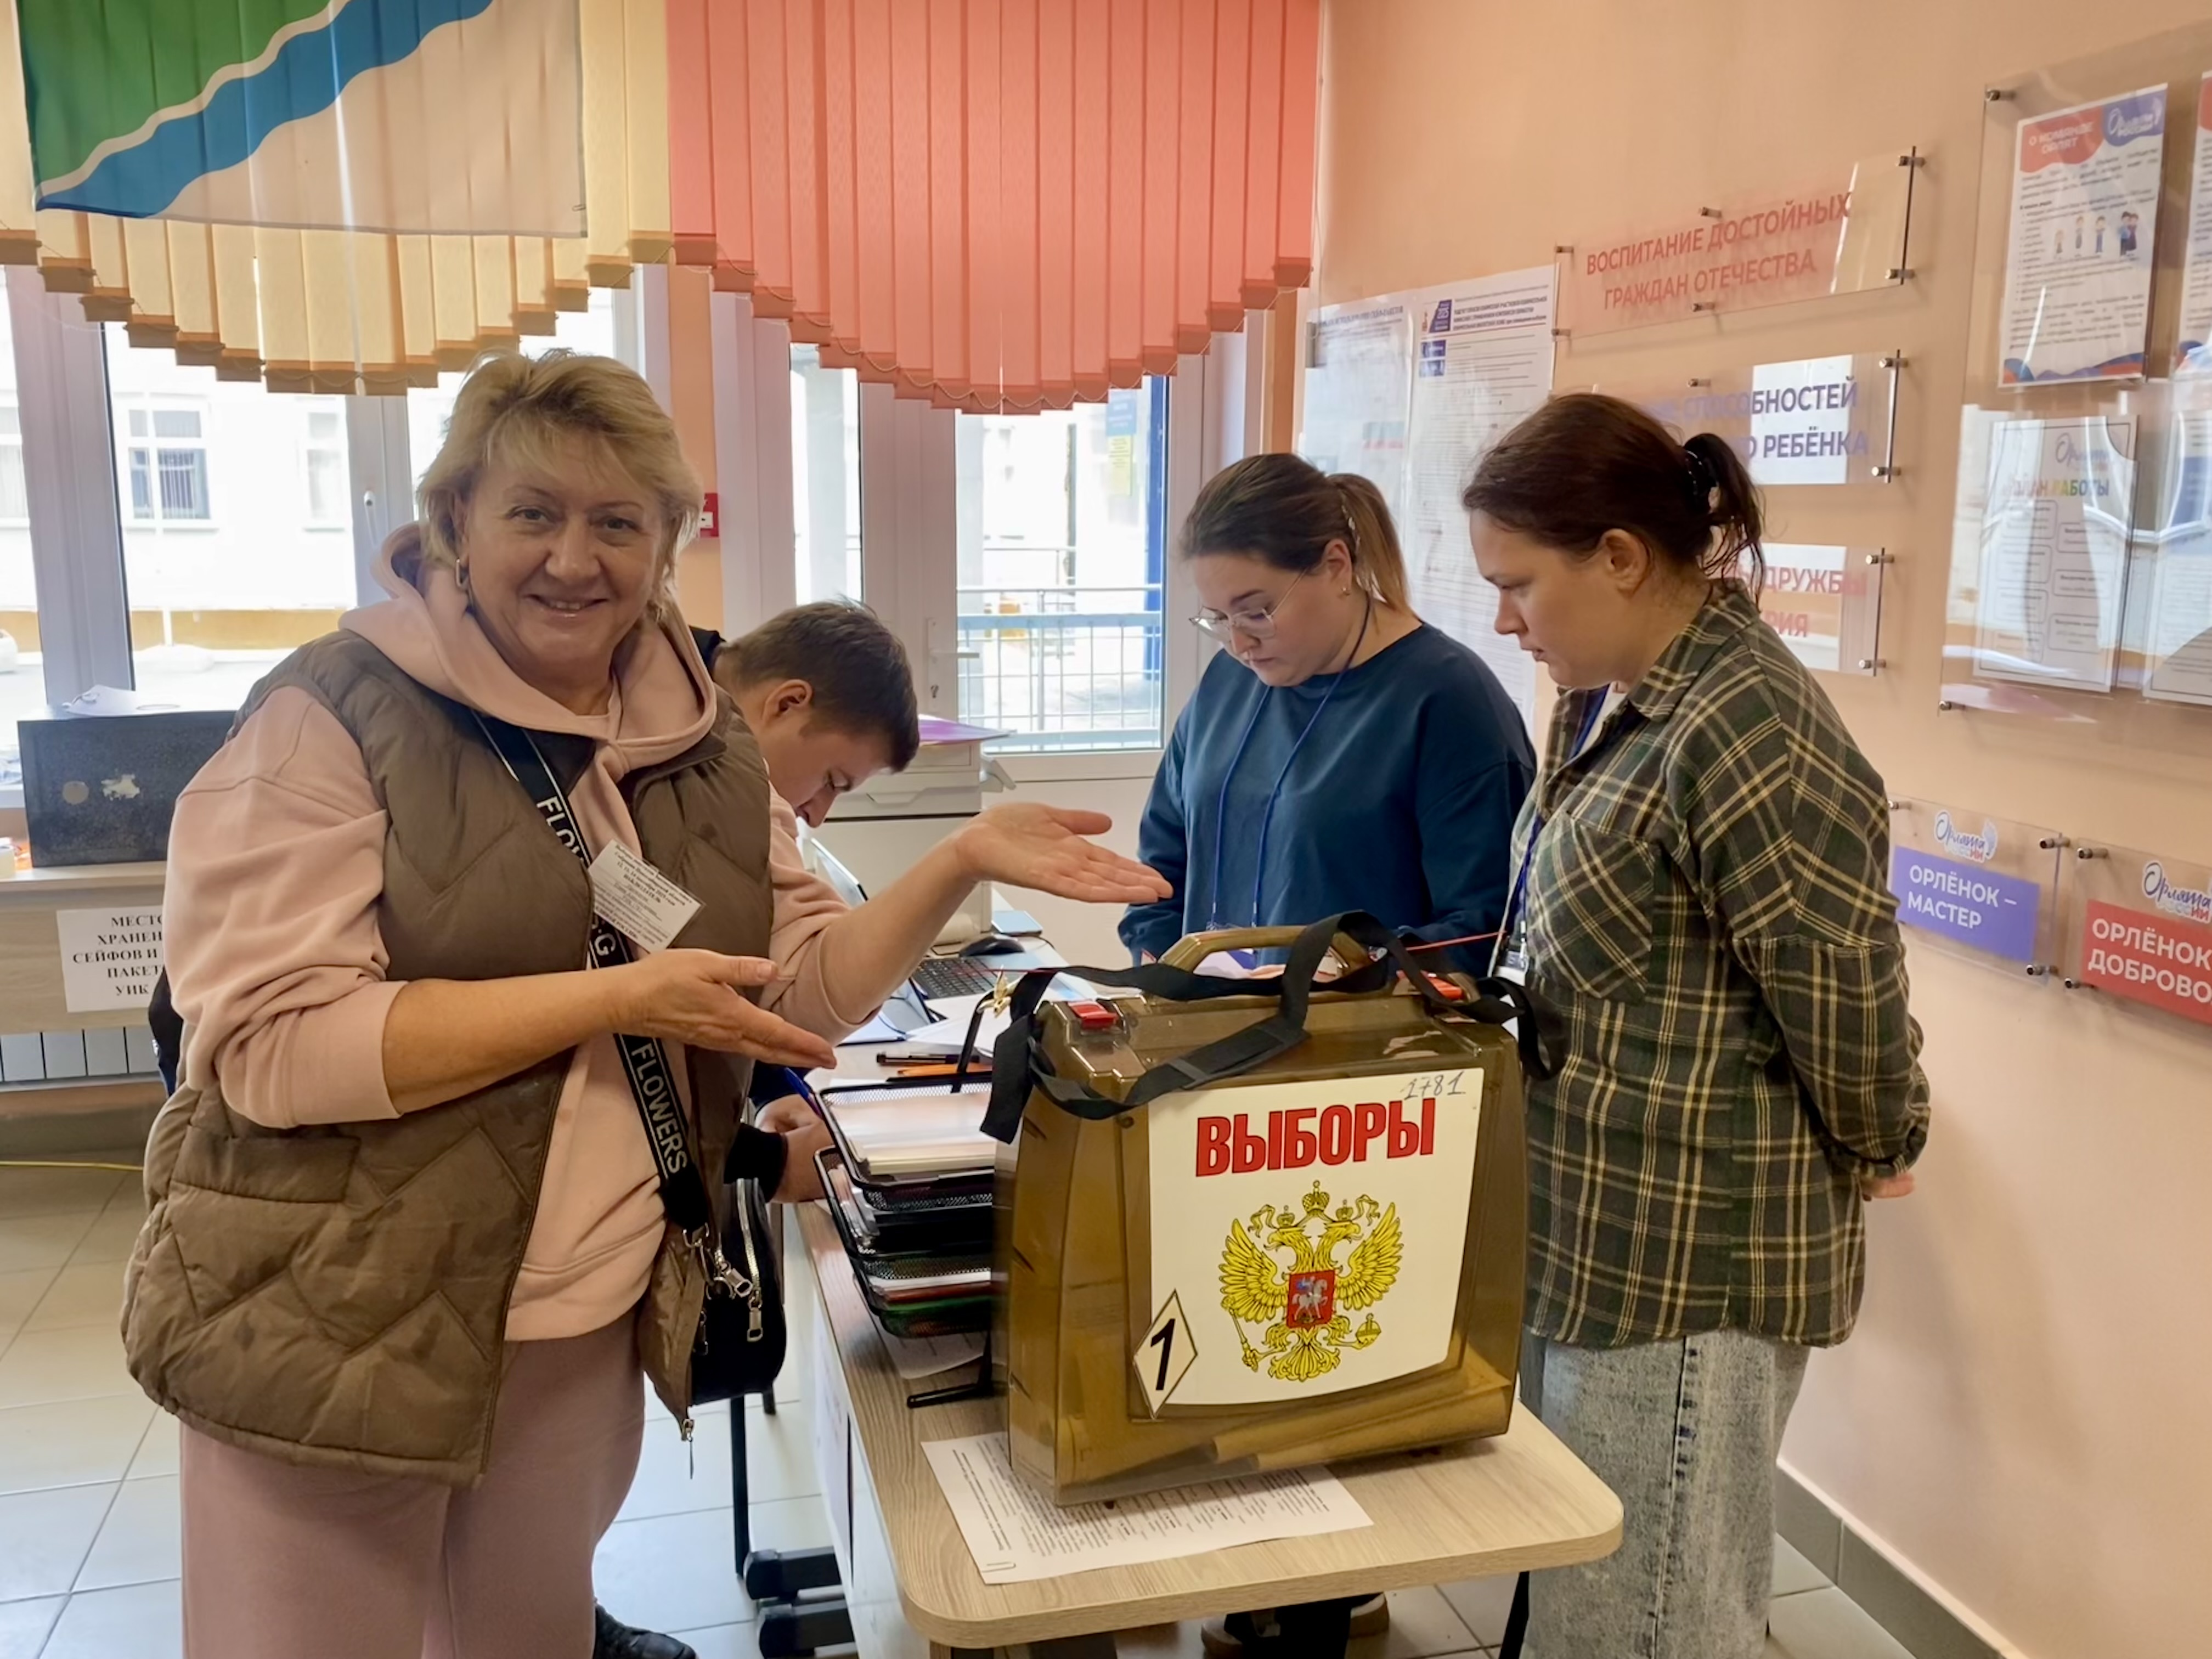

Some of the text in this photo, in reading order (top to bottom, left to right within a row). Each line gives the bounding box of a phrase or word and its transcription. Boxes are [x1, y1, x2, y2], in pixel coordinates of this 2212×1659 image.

[1587, 191, 1852, 275] ВОСПИТАНИЕ ДОСТОЙНЫХ
[1604, 248, 1818, 310] ГРАЖДАН ОТЕЧЕСТВА
[1763, 426, 1870, 459] РЕБЁНКА
[1909, 864, 2000, 908] ОРЛЁНОК
[1907, 890, 1982, 929] МАСТЕР
[73, 948, 157, 964] СЕЙФОВ И
[98, 930, 162, 945] ХРАНЕН
[116, 985, 149, 996] УИК
[2088, 949, 2212, 1005] ДОБРОВО
[631, 1042, 688, 1173] FLOWERS
[1401, 1070, 1467, 1101] 1781
[1195, 1097, 1436, 1177] ВЫБОРЫ
[1150, 1318, 1176, 1391] 1
